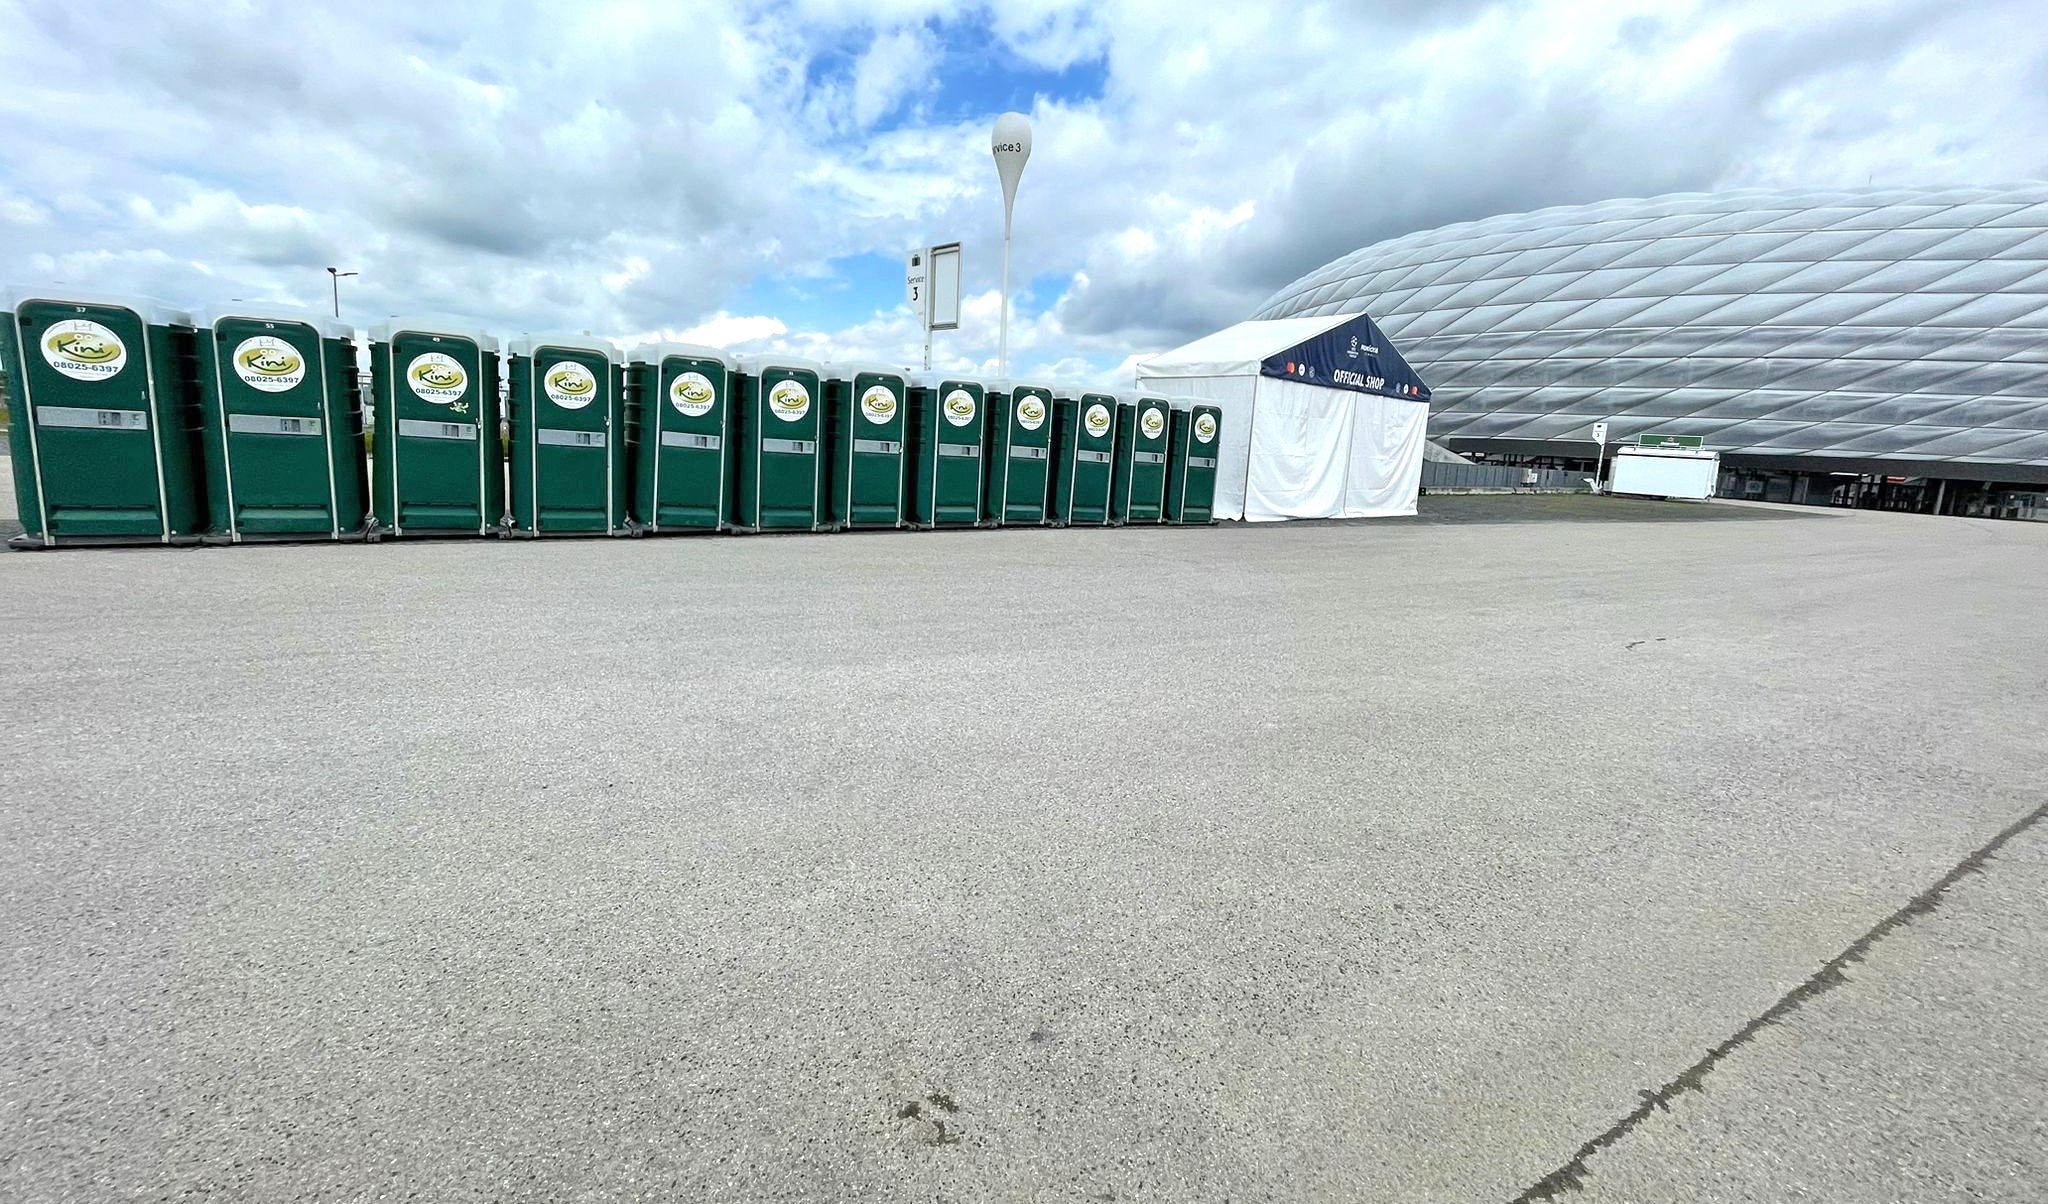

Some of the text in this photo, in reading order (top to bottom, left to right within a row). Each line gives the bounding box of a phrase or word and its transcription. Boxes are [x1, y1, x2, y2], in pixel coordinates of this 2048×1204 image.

[992, 142, 1021, 156] rvice 3
[907, 275, 925, 285] Service
[912, 286, 919, 301] 3
[57, 339, 113, 359] Kini
[53, 361, 119, 373] 08025-6397
[246, 354, 293, 372] Kini
[244, 375, 299, 384] 08025-6397
[418, 369, 458, 386] Kini
[554, 377, 588, 392] Kini
[1333, 369, 1385, 390] OFFICIAL SHOP
[415, 387, 462, 397] 08025-6397
[550, 393, 591, 402] 08025-6397
[679, 386, 709, 401] Kini
[777, 393, 804, 407] Kini
[868, 397, 892, 411] Kini
